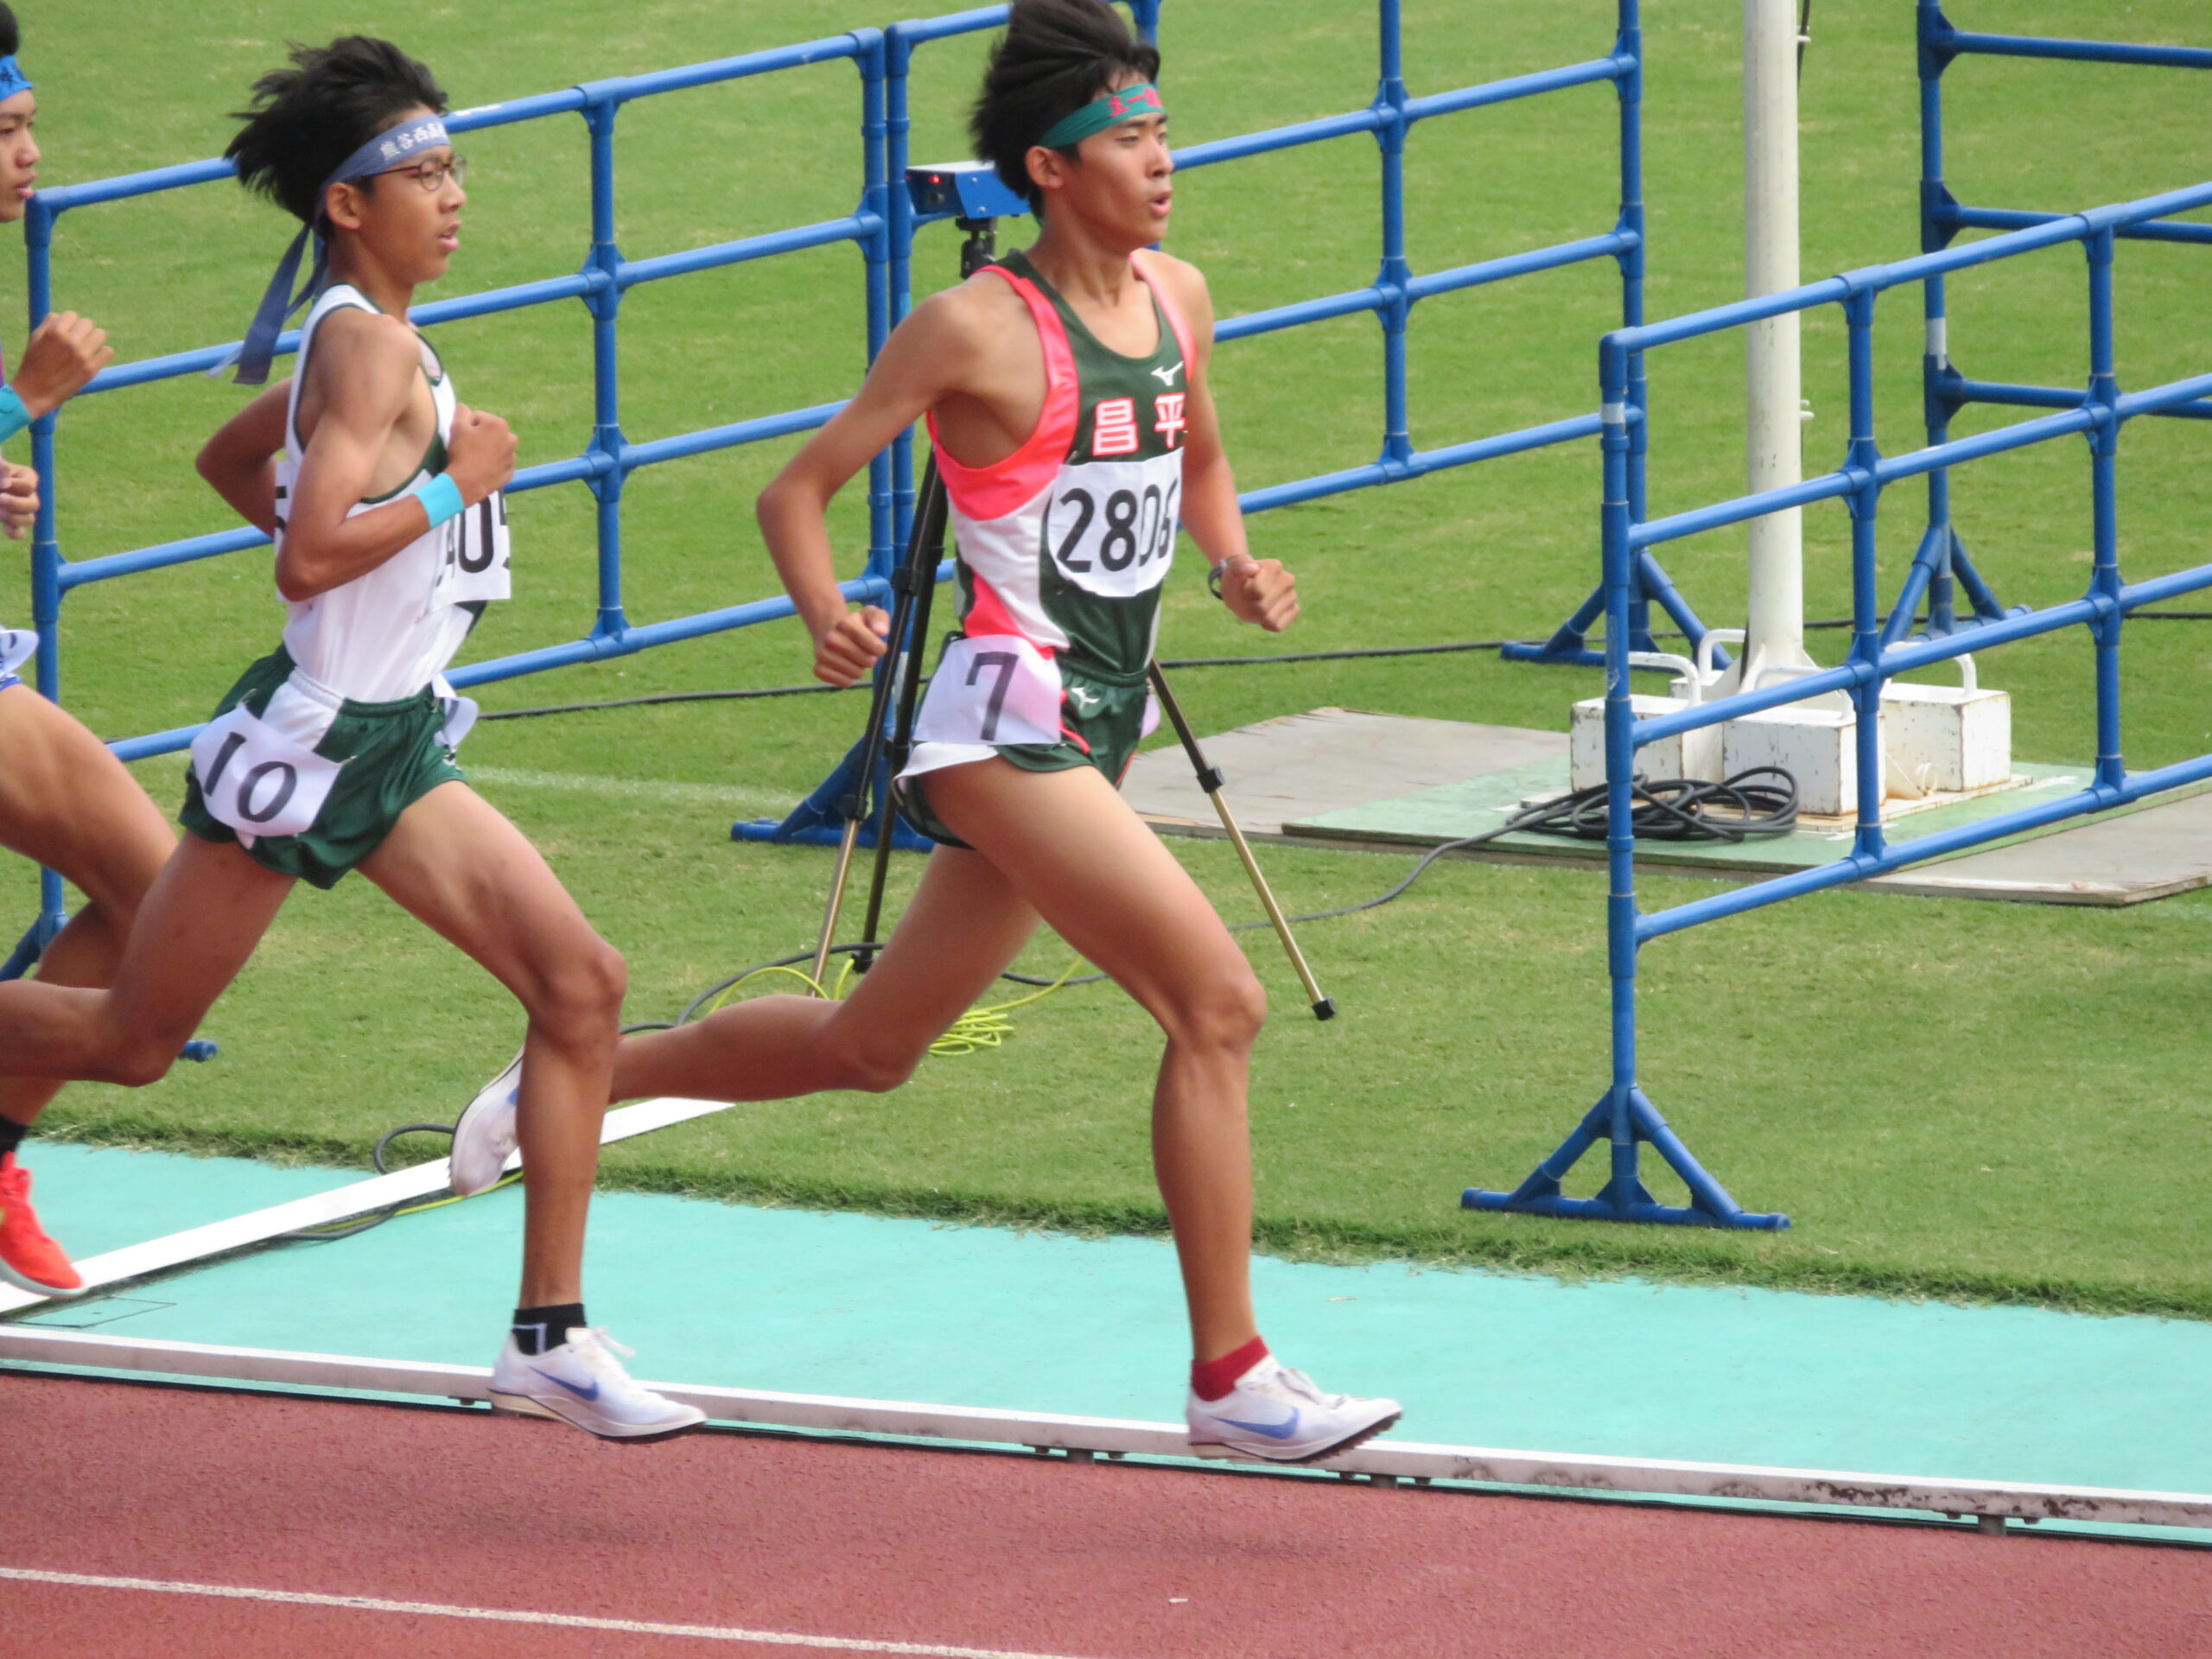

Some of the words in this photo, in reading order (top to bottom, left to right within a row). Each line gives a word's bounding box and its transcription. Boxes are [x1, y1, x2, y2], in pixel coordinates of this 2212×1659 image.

[1091, 391, 1187, 456] 昌平
[965, 651, 1019, 741] 7
[204, 731, 298, 823] 10
